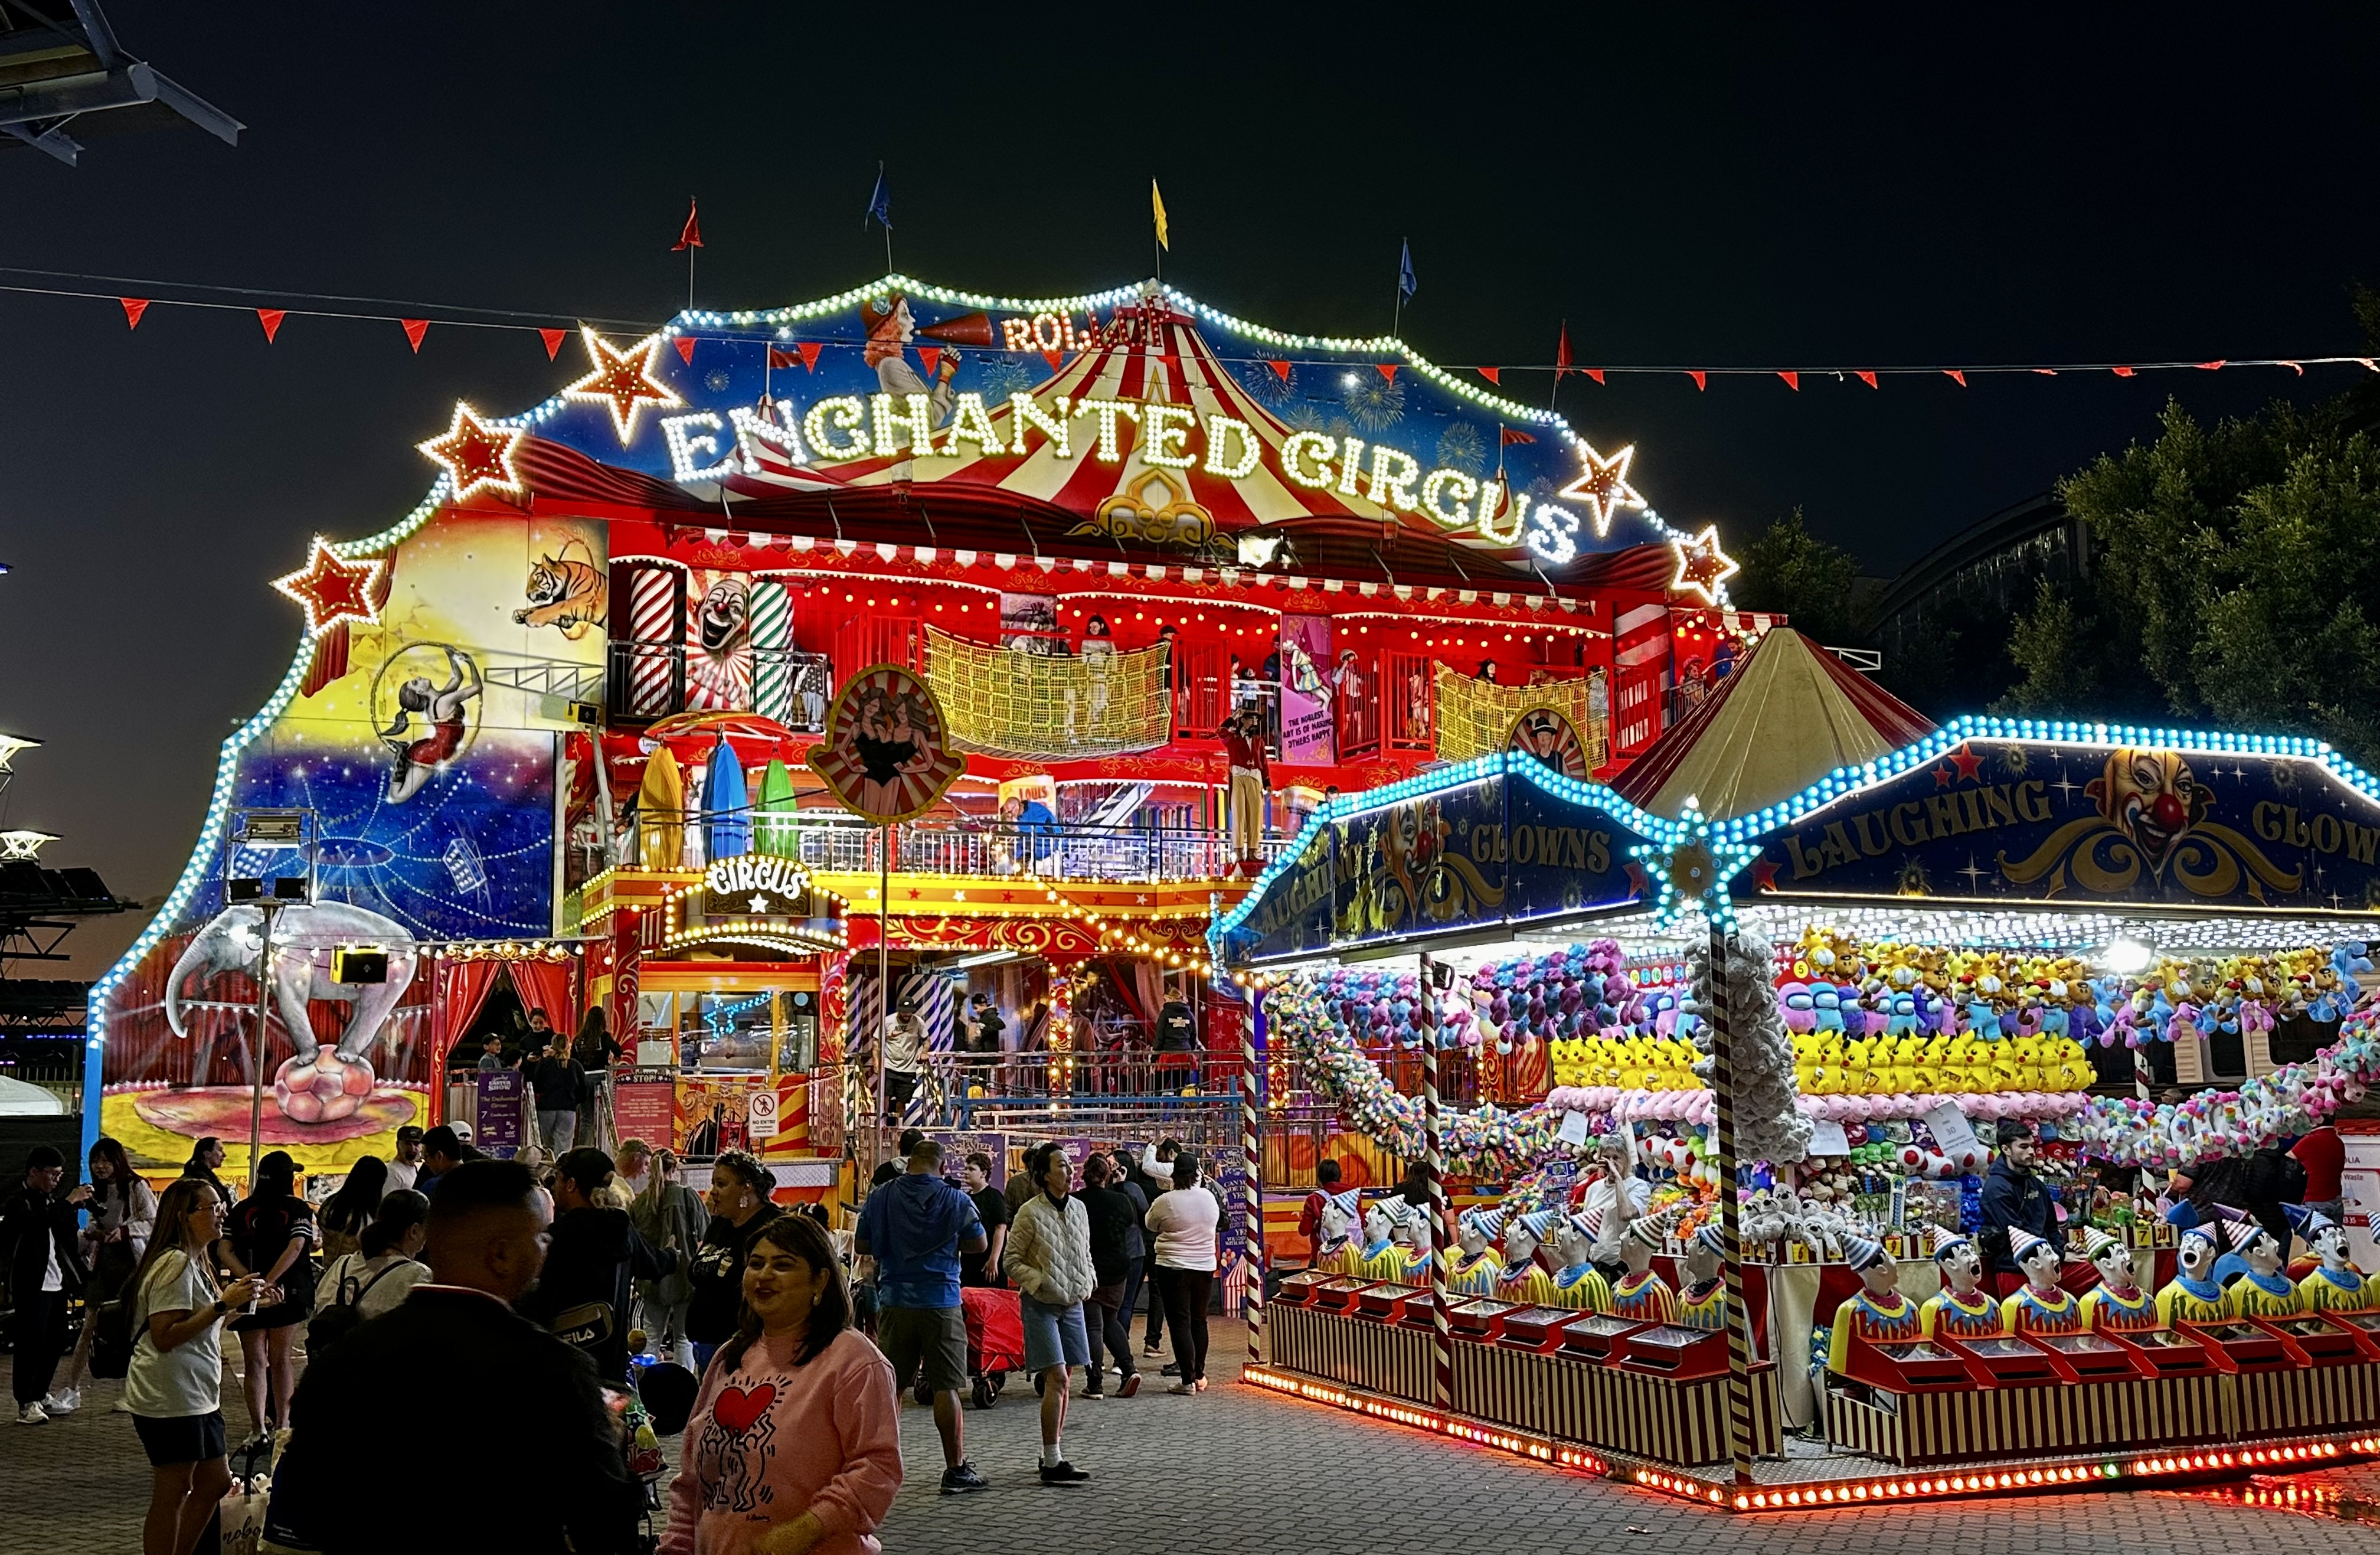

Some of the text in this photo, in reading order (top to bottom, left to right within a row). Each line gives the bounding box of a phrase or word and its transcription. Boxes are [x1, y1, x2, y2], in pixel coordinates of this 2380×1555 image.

[660, 391, 1581, 566] ENCHANTED CIRCUS
[1288, 718, 1299, 727] THE
[1283, 729, 1293, 738] ART
[1296, 727, 1301, 736] IS
[1303, 724, 1310, 733] OF
[1288, 729, 1330, 748] OTHERS HAPPY
[1781, 780, 2053, 880] LAUGHING
[1472, 824, 1610, 874] CLOWNS
[710, 861, 808, 900] CIRCUS
[1799, 965, 1804, 974] 5
[481, 1110, 488, 1120] 7
[2139, 1230, 2147, 1242] 7
[1799, 1244, 1803, 1260] 6
[1891, 1240, 1897, 1253] 9
[562, 1328, 595, 1343] FILA
